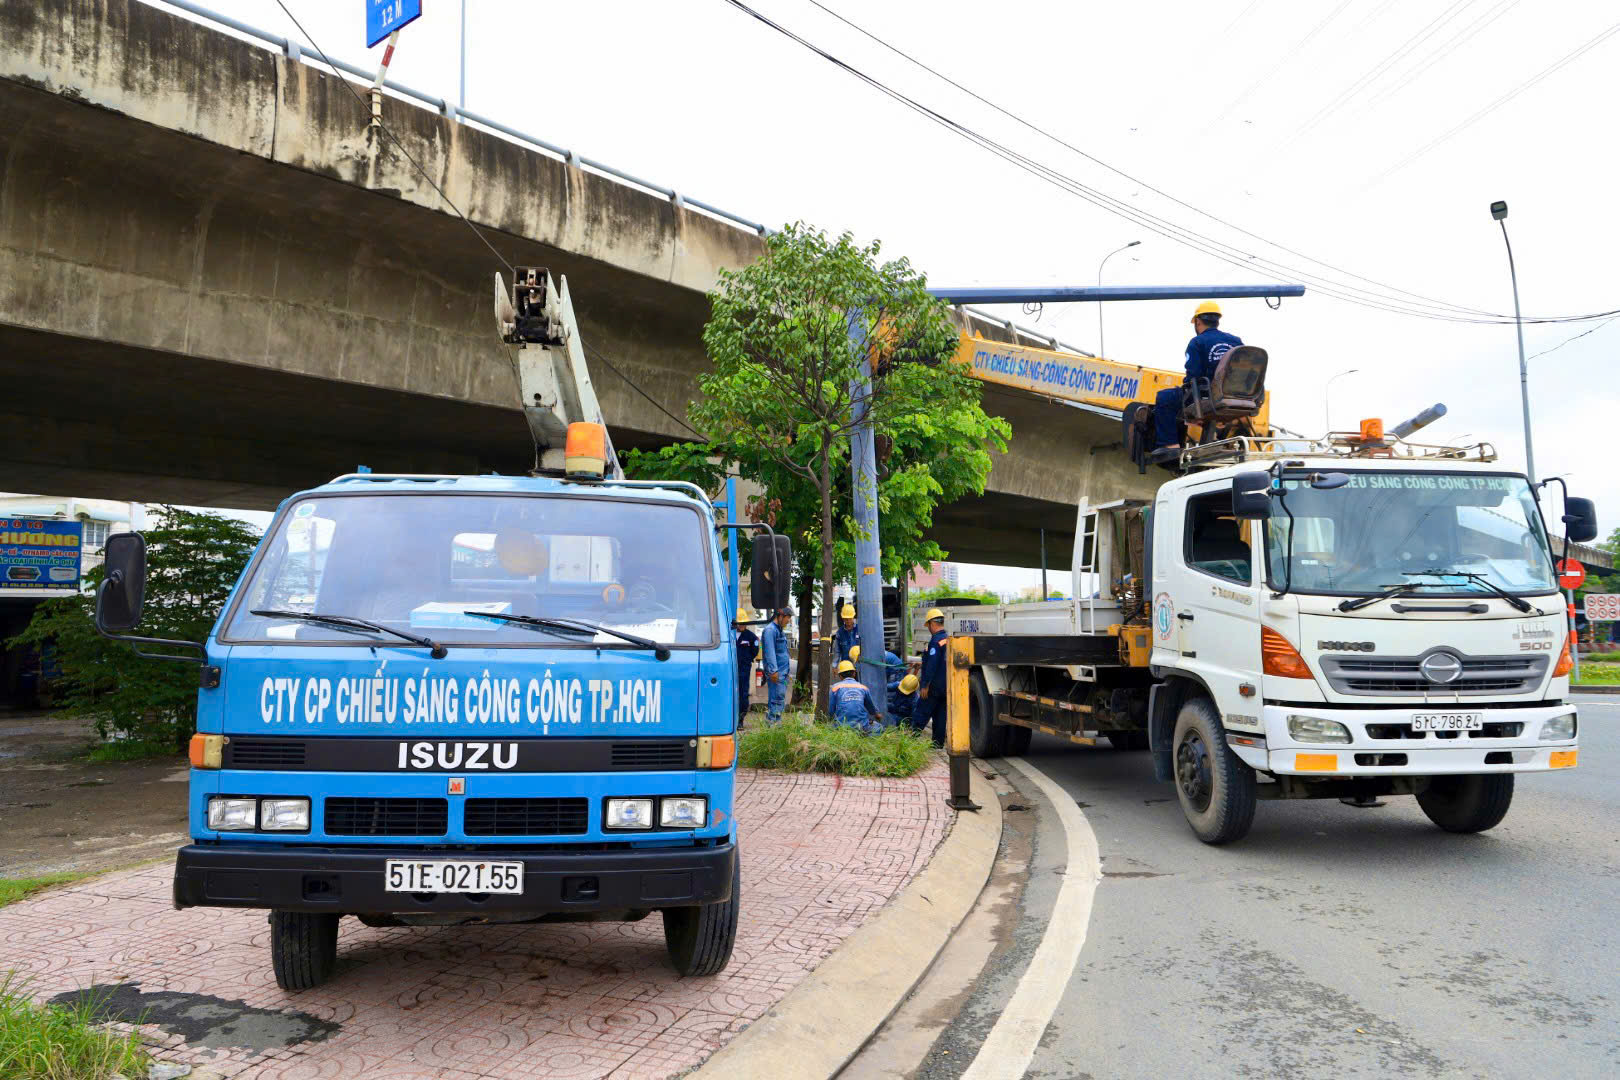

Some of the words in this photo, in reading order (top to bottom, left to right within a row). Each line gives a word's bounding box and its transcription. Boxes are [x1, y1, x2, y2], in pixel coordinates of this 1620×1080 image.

[381, 5, 393, 28] 12
[975, 351, 991, 369] CTY
[1098, 373, 1139, 399] TP.HCM
[1371, 474, 1402, 488] SÁNG
[1404, 475, 1436, 489] CÔNG
[1439, 476, 1469, 490] CỘNG
[1317, 640, 1376, 652] HINO
[1519, 642, 1552, 650] 500
[261, 677, 301, 723] CTY
[304, 677, 332, 723] CP
[336, 659, 398, 723] CHIẾU
[403, 667, 459, 724] SÁNG
[464, 668, 520, 724] CÔNG
[526, 668, 583, 735] CỘNG
[588, 679, 661, 724] TP.HCM
[398, 742, 518, 769] ISUZU
[390, 863, 518, 890] 51E-021.55
